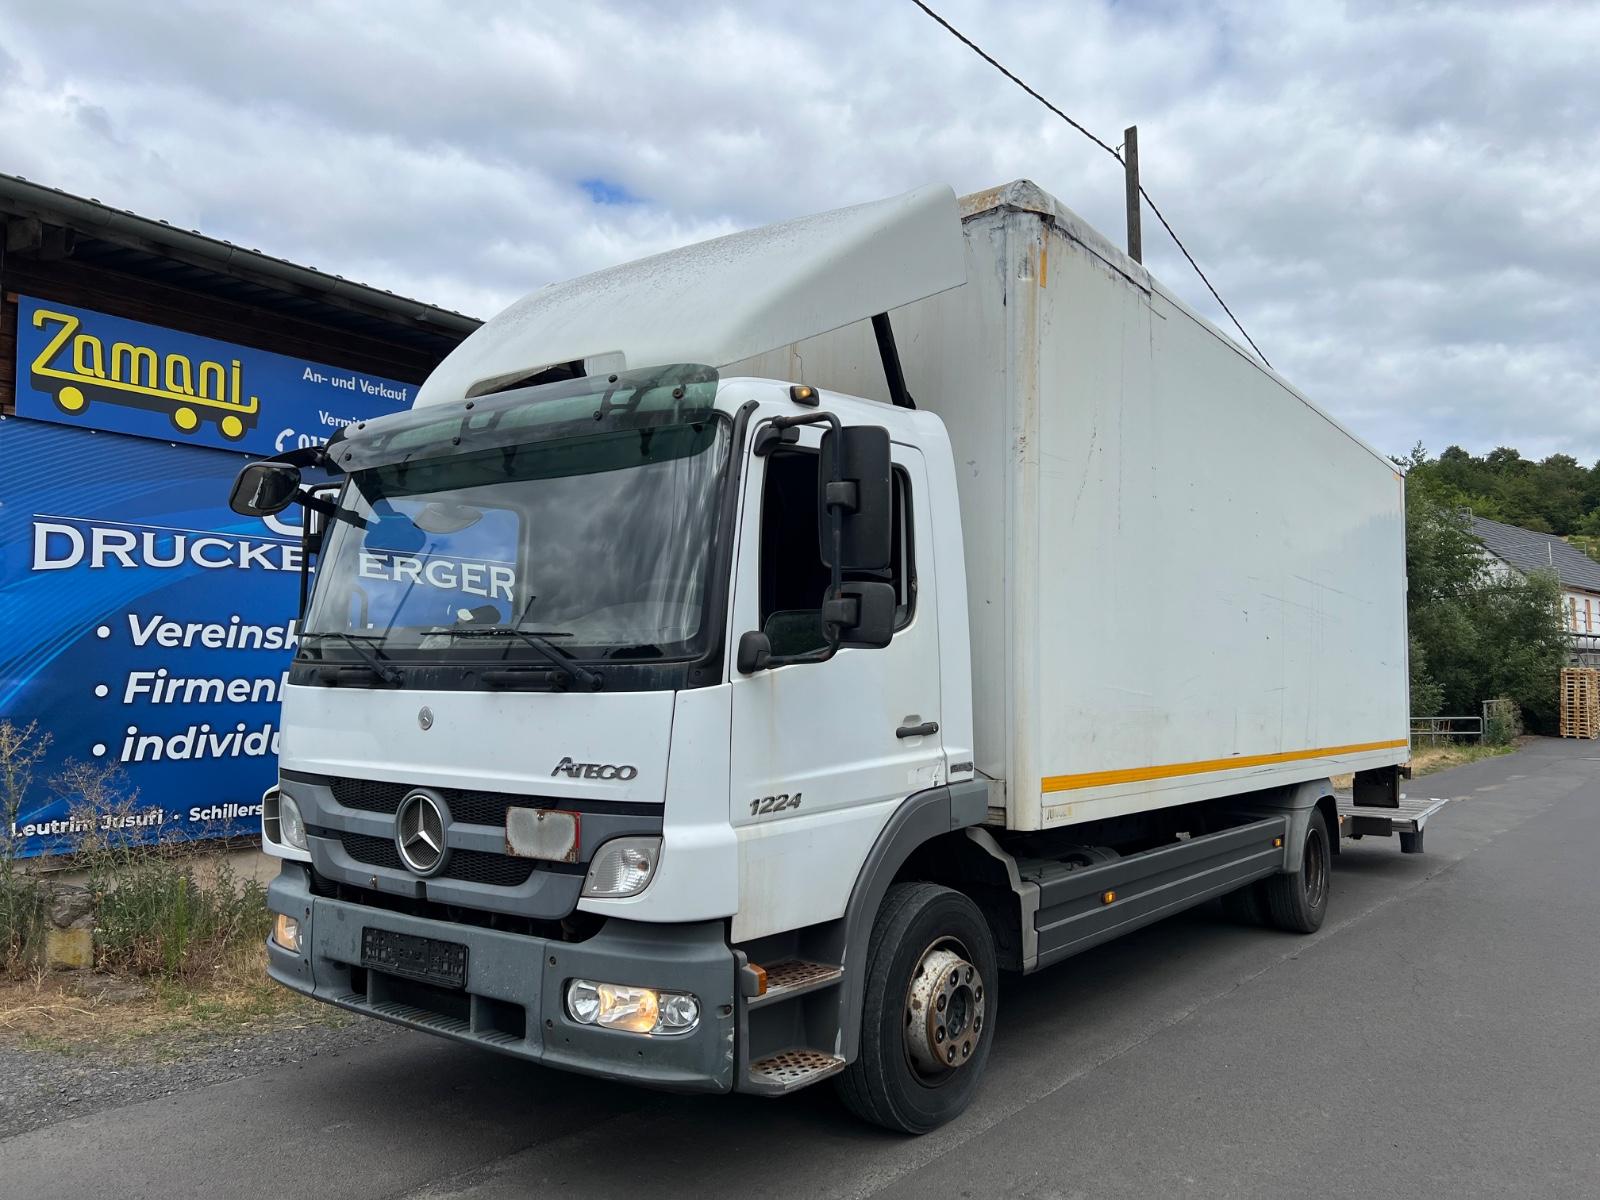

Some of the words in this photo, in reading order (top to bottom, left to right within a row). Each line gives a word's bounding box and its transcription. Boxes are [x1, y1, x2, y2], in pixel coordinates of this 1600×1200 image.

[31, 309, 258, 414] Zamani
[303, 367, 328, 383] An-
[331, 377, 355, 391] und
[360, 379, 407, 401] Verkauf
[750, 793, 802, 816] 1224
